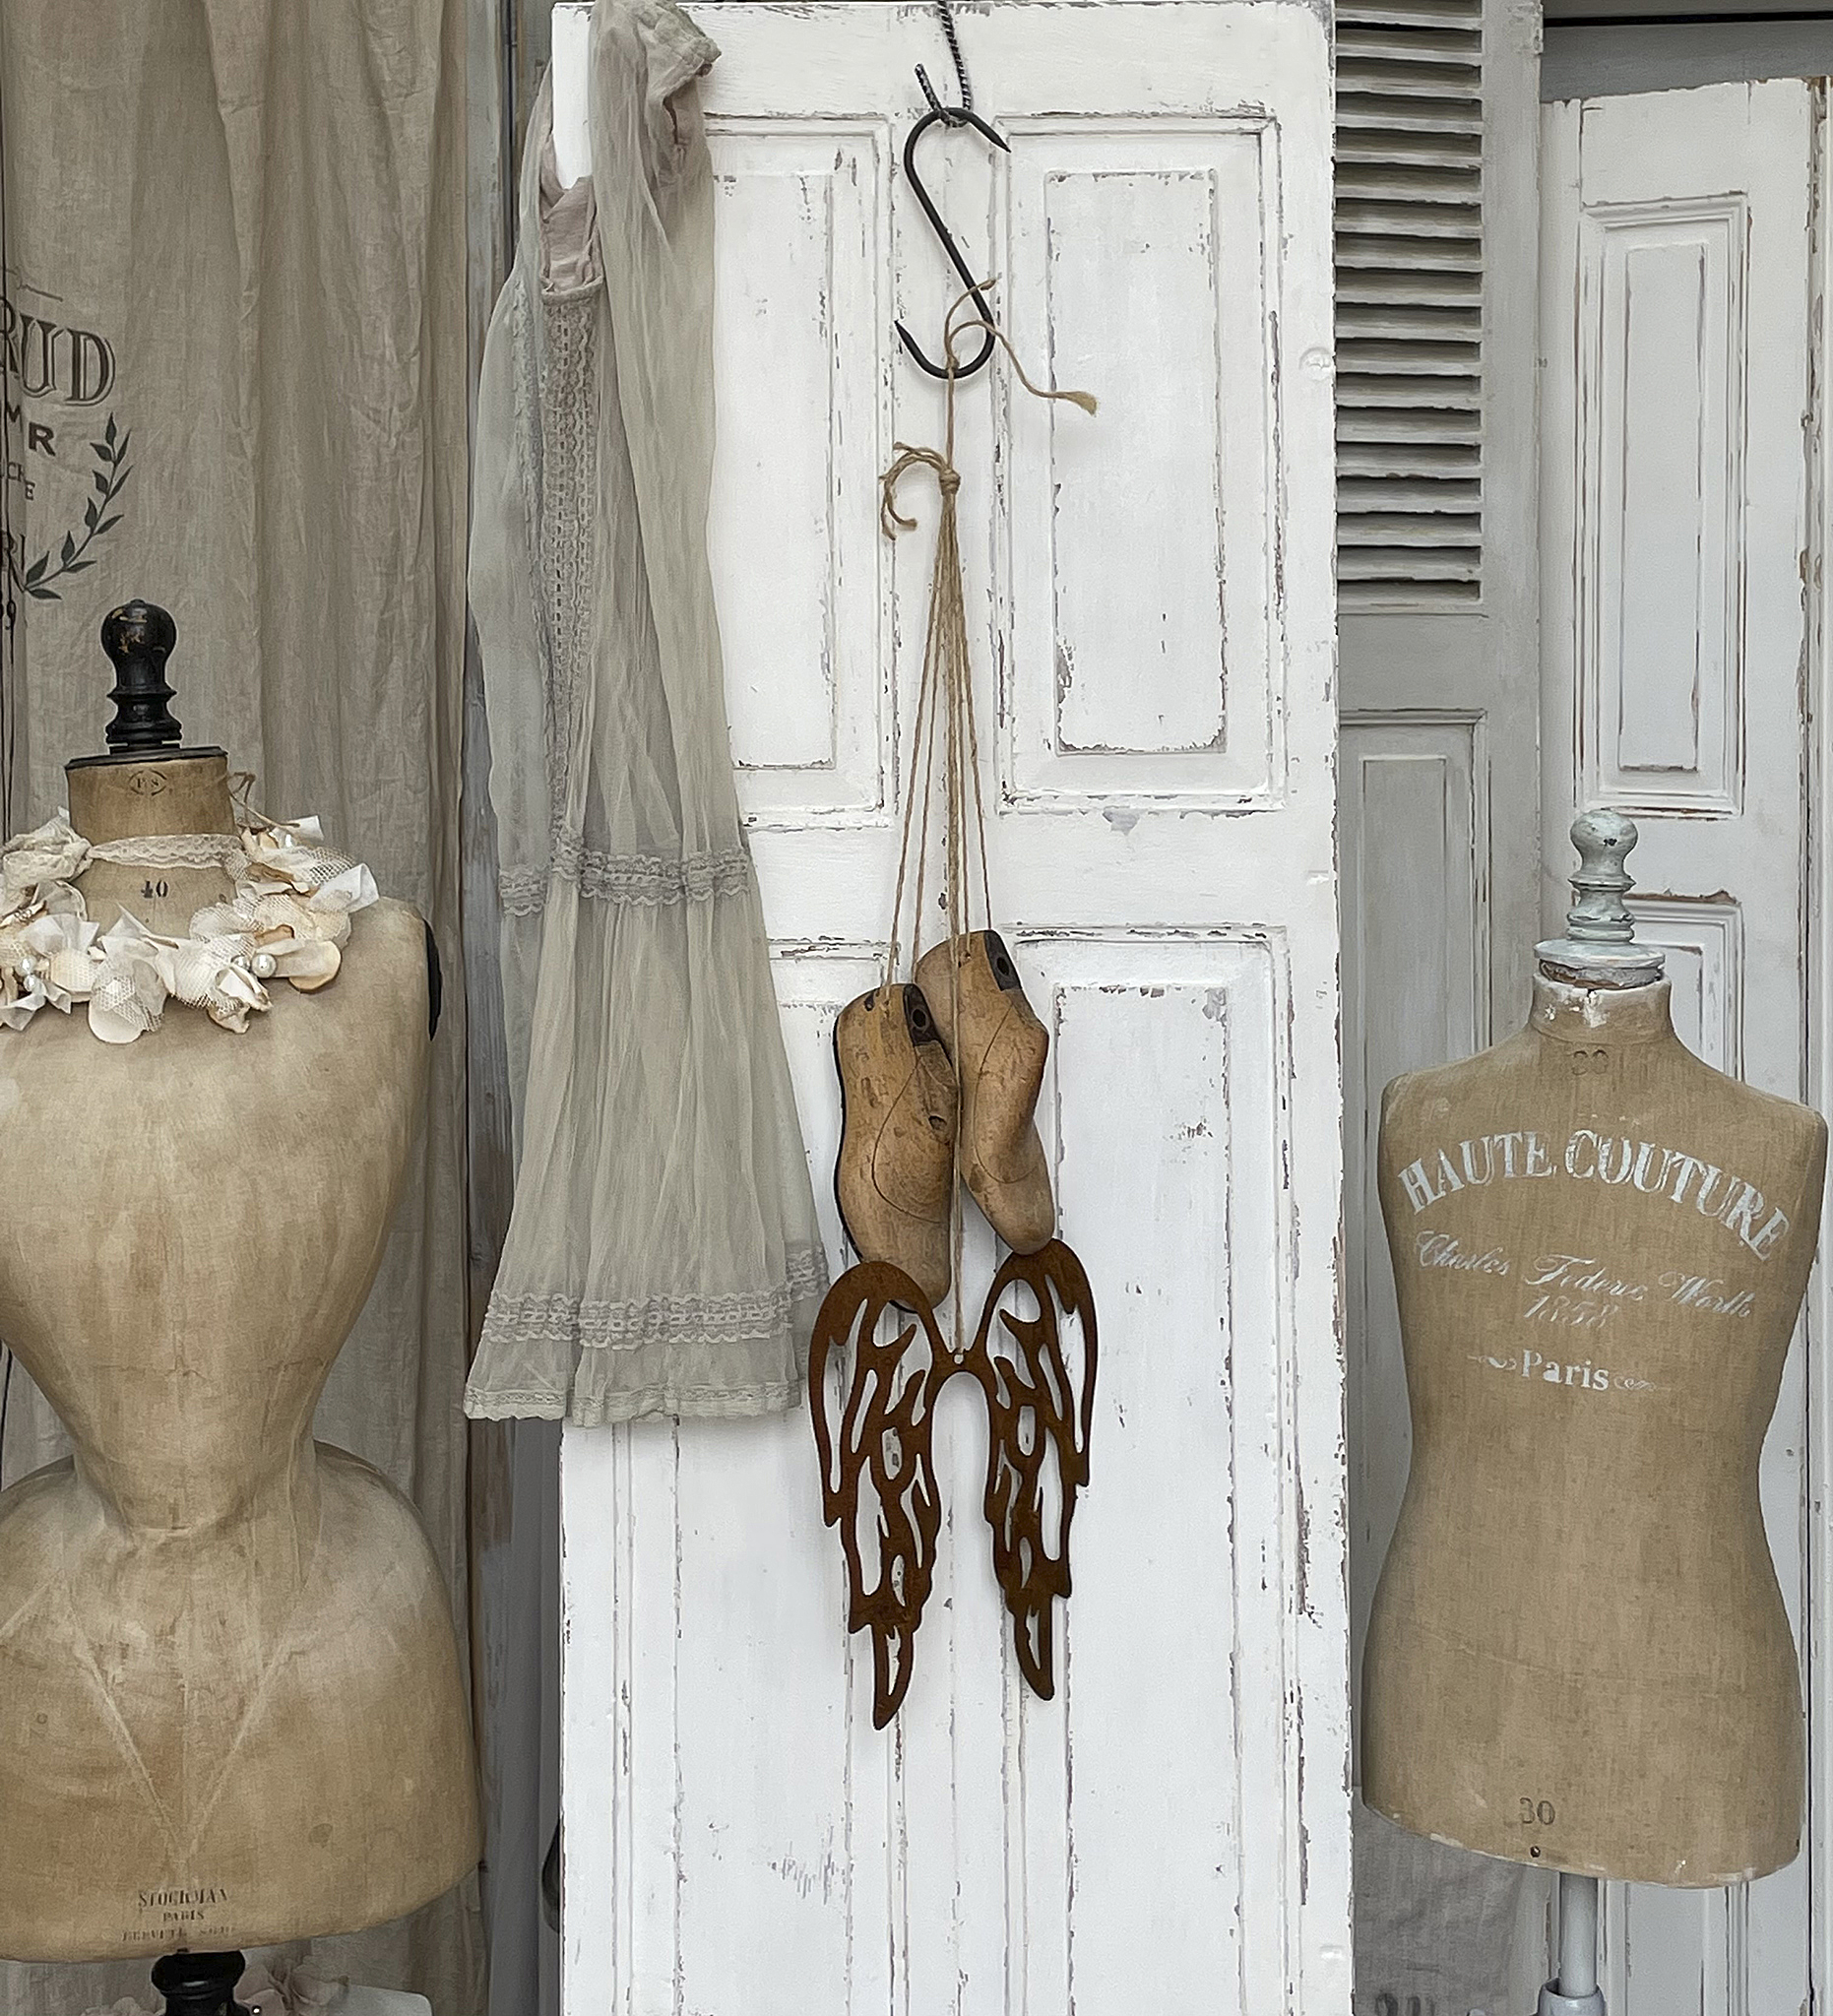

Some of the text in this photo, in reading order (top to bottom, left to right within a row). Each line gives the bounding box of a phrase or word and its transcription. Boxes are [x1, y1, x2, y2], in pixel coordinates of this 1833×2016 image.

[141, 880, 168, 899] 40
[1397, 1129, 1790, 1262] HAUTE COUTURE
[1521, 1349, 1610, 1392] Paris
[1519, 1796, 1555, 1825] 30
